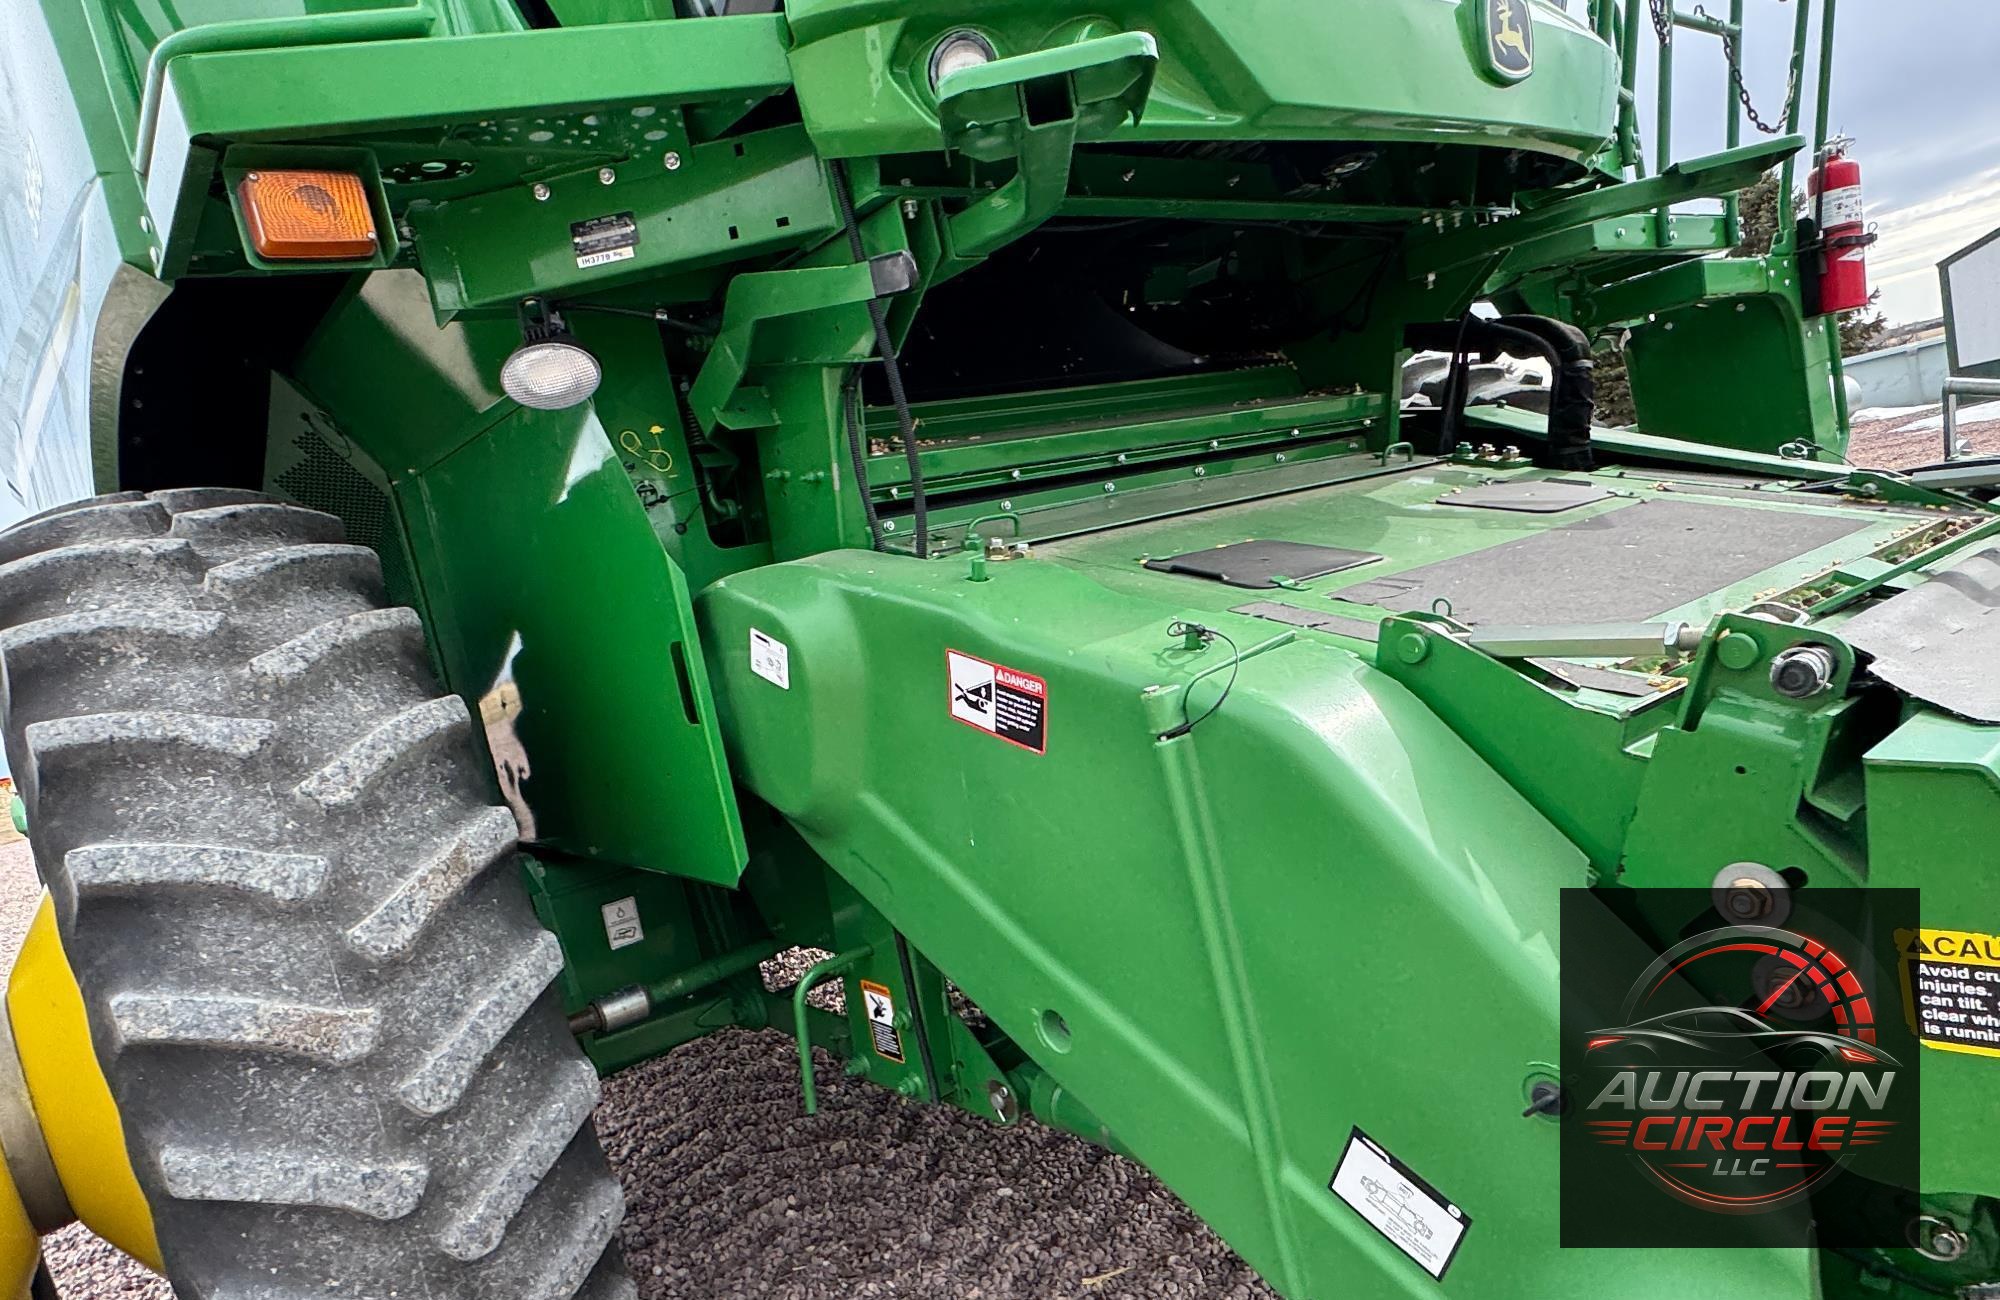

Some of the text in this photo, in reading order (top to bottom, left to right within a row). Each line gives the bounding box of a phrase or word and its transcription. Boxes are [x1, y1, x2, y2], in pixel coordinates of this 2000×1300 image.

[1004, 671, 1043, 694] DANGER
[1918, 963, 1970, 980] Avoid
[1919, 977, 1993, 997] injuries.
[1920, 995, 1954, 1008] can
[1957, 996, 1989, 1011] tilt.
[1922, 1008, 2000, 1028] clear wh
[1924, 1021, 1941, 1035] is
